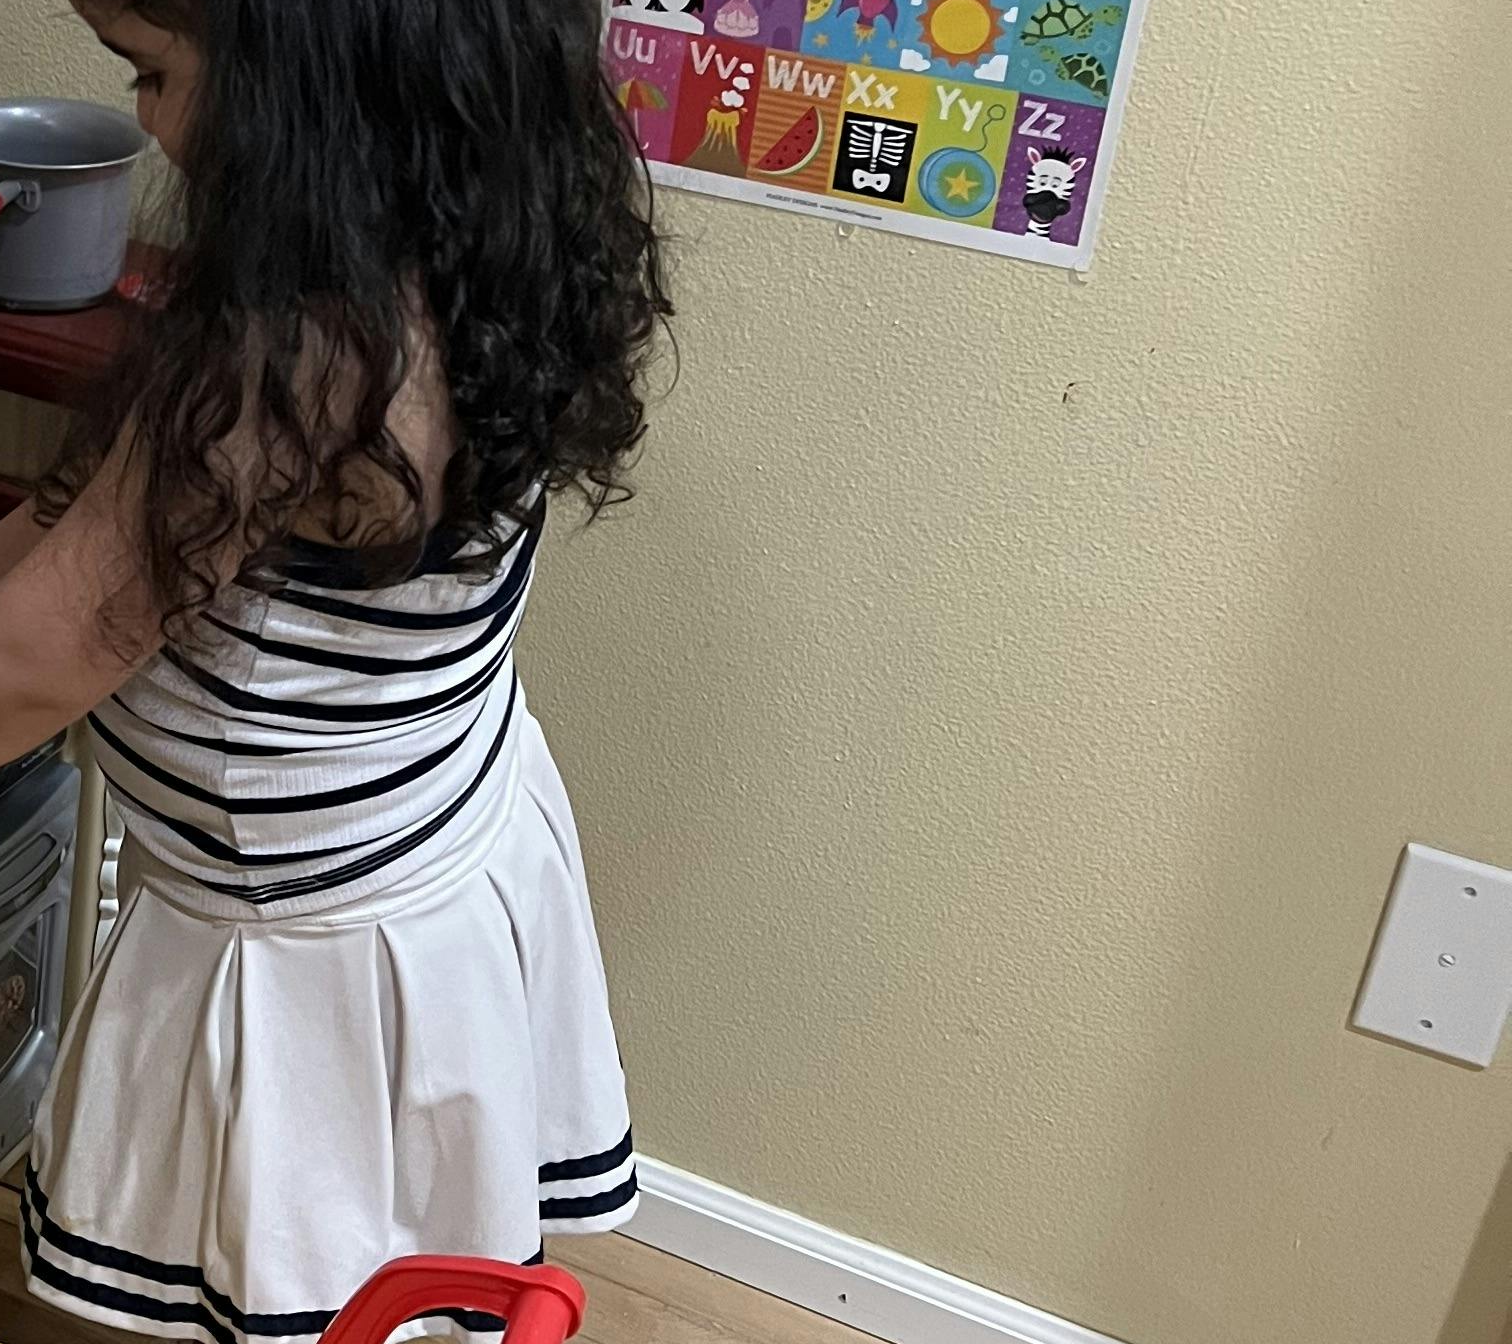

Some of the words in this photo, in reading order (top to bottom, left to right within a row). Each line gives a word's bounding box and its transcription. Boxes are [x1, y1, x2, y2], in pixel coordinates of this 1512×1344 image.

[613, 27, 656, 64] Uu
[690, 41, 734, 80] Vv
[767, 57, 835, 99] Ww
[847, 72, 896, 109] Xx
[934, 85, 983, 133] Yy
[1019, 100, 1065, 142] Zz
